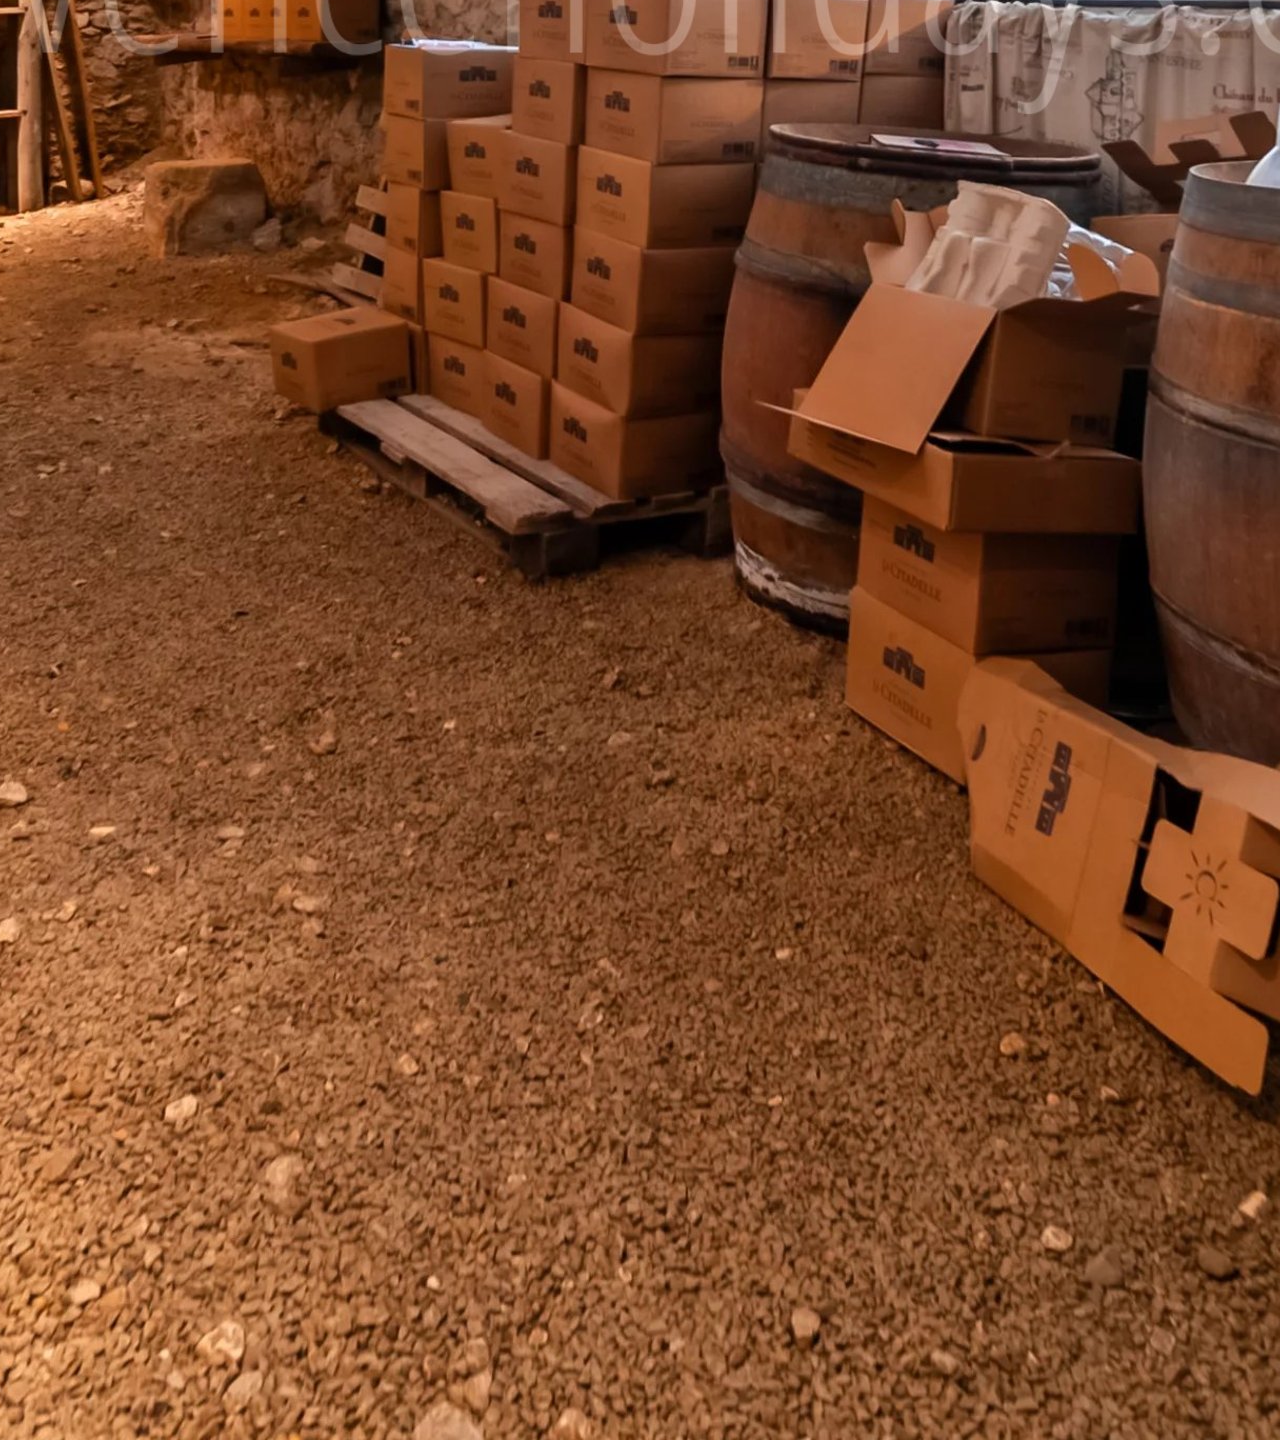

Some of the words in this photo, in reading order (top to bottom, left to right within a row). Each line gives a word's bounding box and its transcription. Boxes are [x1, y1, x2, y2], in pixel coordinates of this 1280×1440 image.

[890, 566, 942, 603] CITADELLE
[880, 684, 933, 731] CITADELLE
[1004, 726, 1044, 838] CITADELLE
